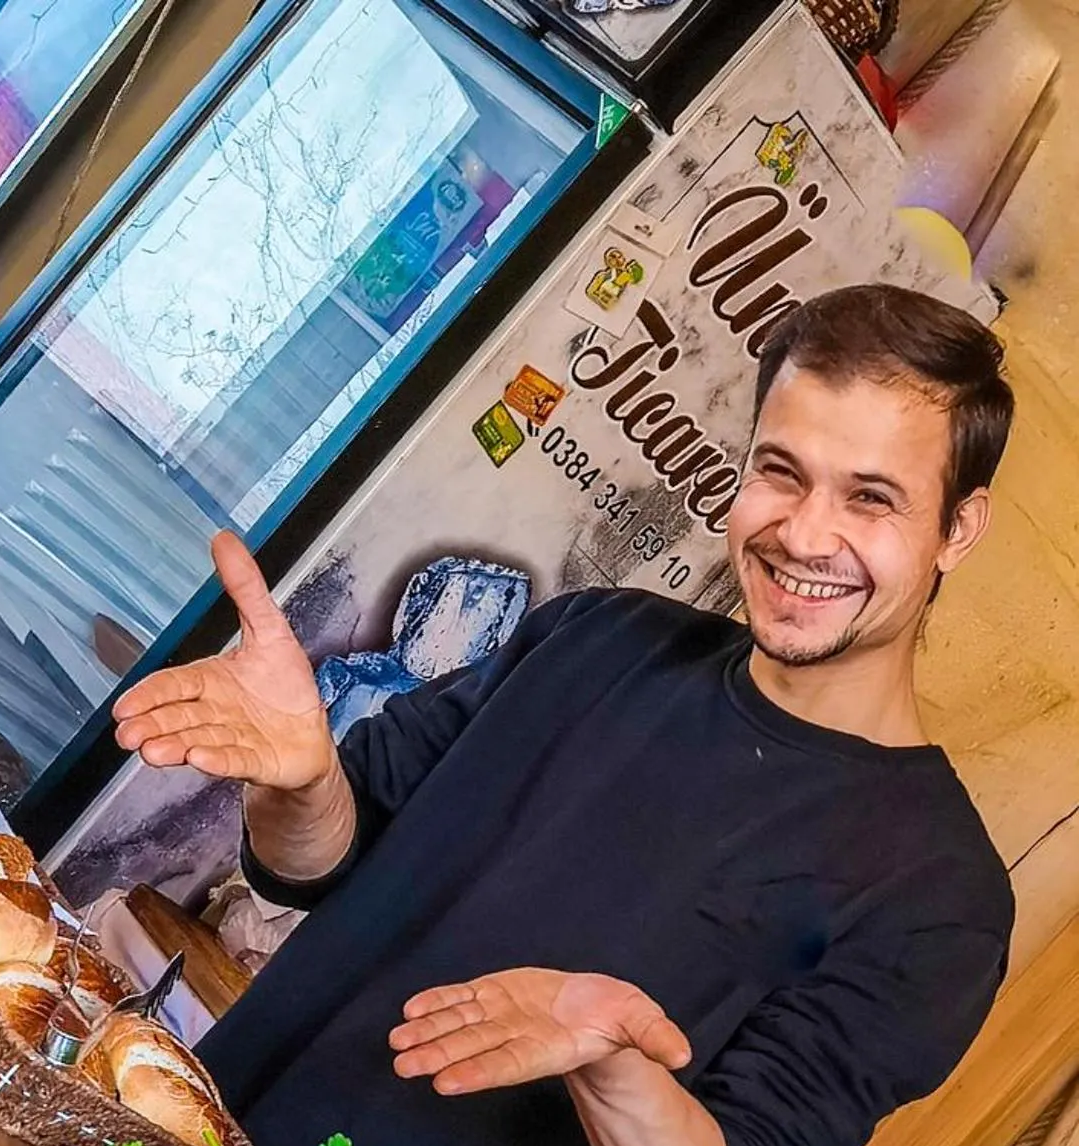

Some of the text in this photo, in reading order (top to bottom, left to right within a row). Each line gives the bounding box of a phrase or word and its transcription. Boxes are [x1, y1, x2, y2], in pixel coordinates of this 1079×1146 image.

[541, 426, 691, 590] 0384 341 59 10
